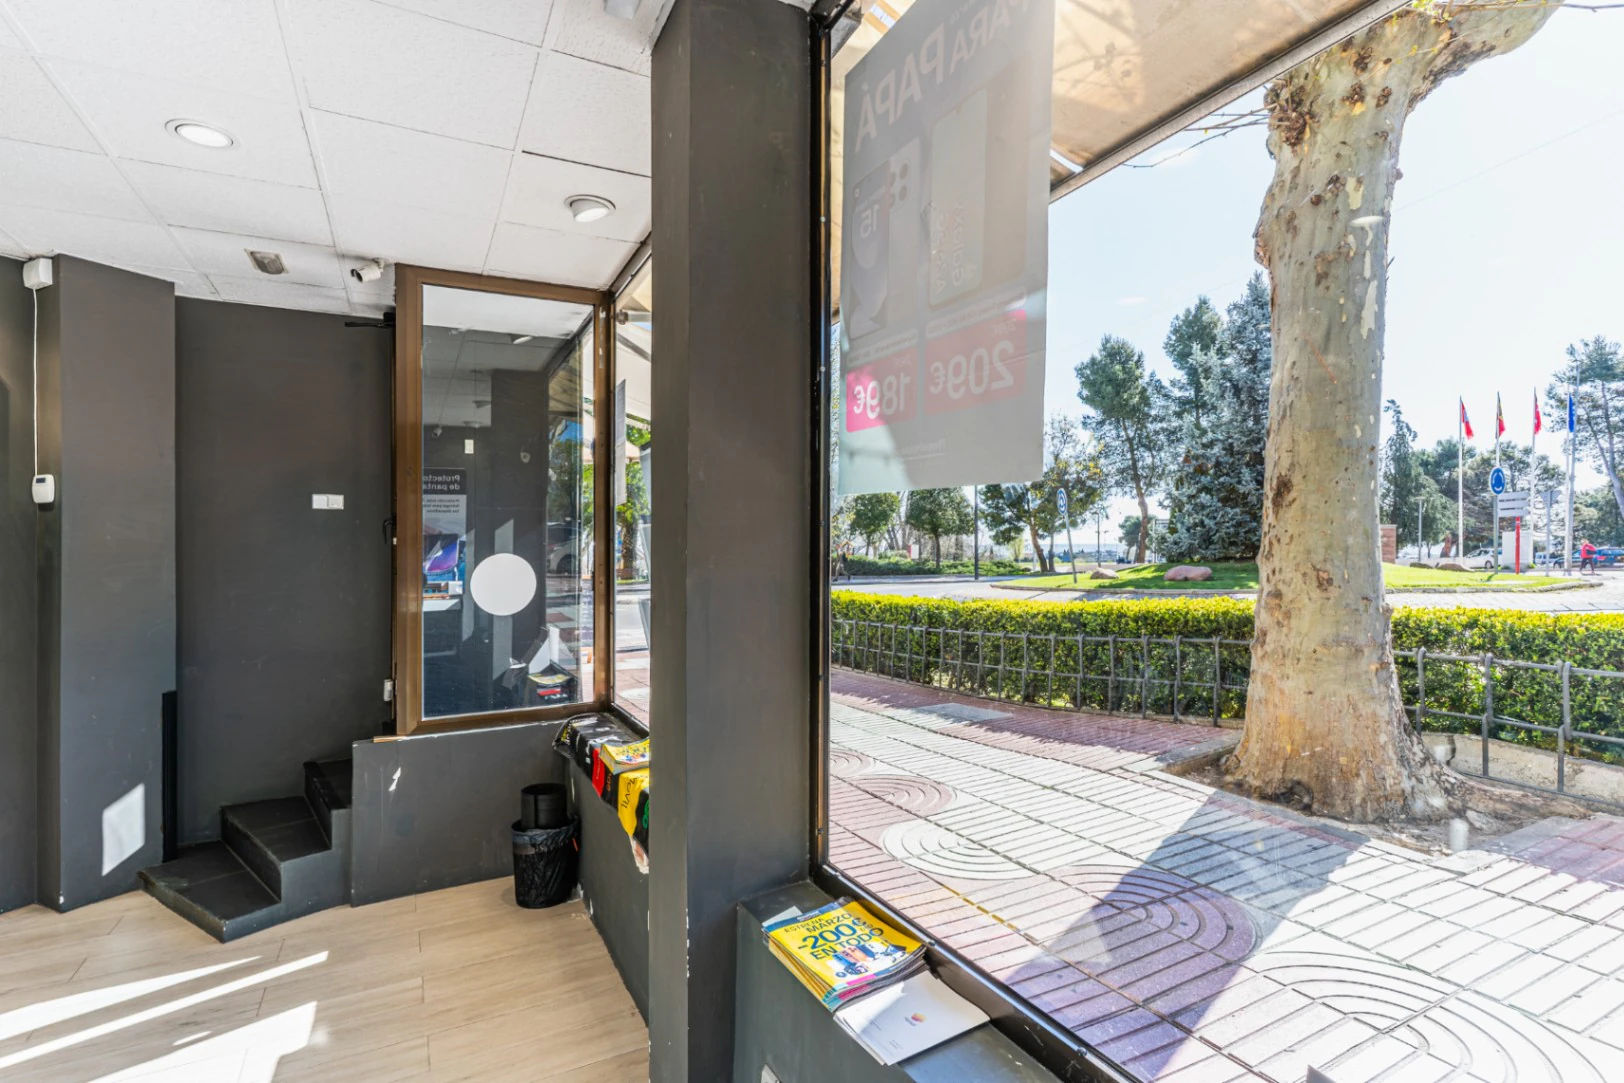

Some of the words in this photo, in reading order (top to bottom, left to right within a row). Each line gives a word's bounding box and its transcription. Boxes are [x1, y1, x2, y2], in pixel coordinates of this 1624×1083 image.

[806, 913, 852, 933] MARZO
[810, 945, 838, 960] EN
[835, 927, 884, 948] TODO
